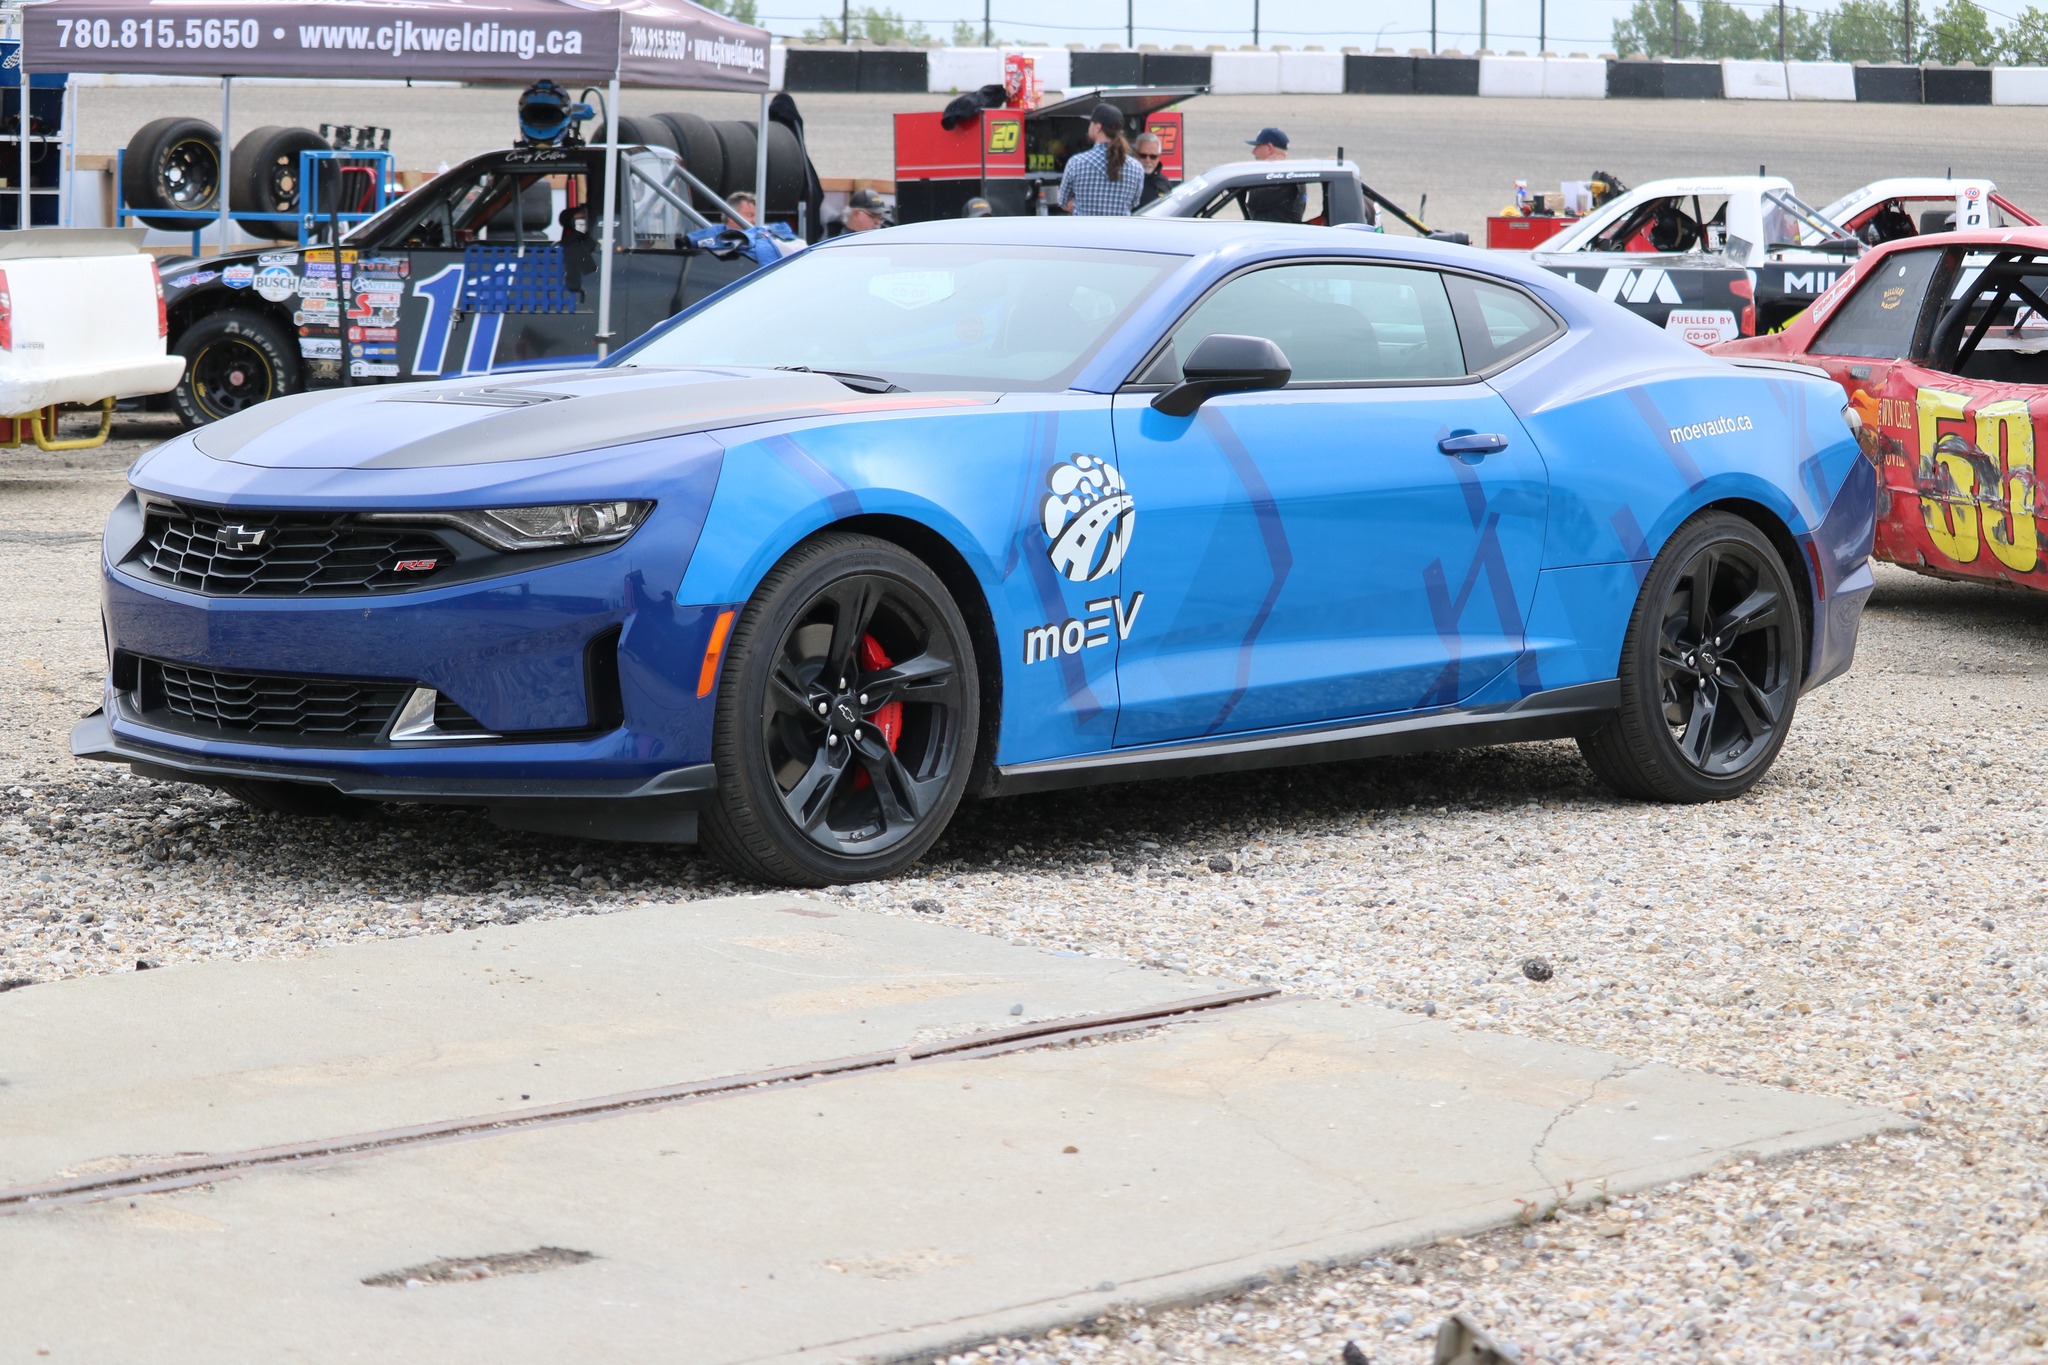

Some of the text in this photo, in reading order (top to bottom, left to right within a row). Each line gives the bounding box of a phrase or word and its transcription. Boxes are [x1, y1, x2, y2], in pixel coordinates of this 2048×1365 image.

[57, 19, 582, 59] 780.815.5650 www.cjkwelding.ca
[628, 26, 686, 60] 780.815.5650
[988, 121, 1021, 153] 20
[256, 276, 296, 290] BUSCH
[1671, 316, 1732, 324] FUELLED BY
[224, 321, 286, 393] AMERICAN
[176, 386, 204, 425] ACER
[1894, 399, 1912, 430] CARE
[1669, 415, 1753, 444] moevauto.ca
[394, 559, 438, 571] RS
